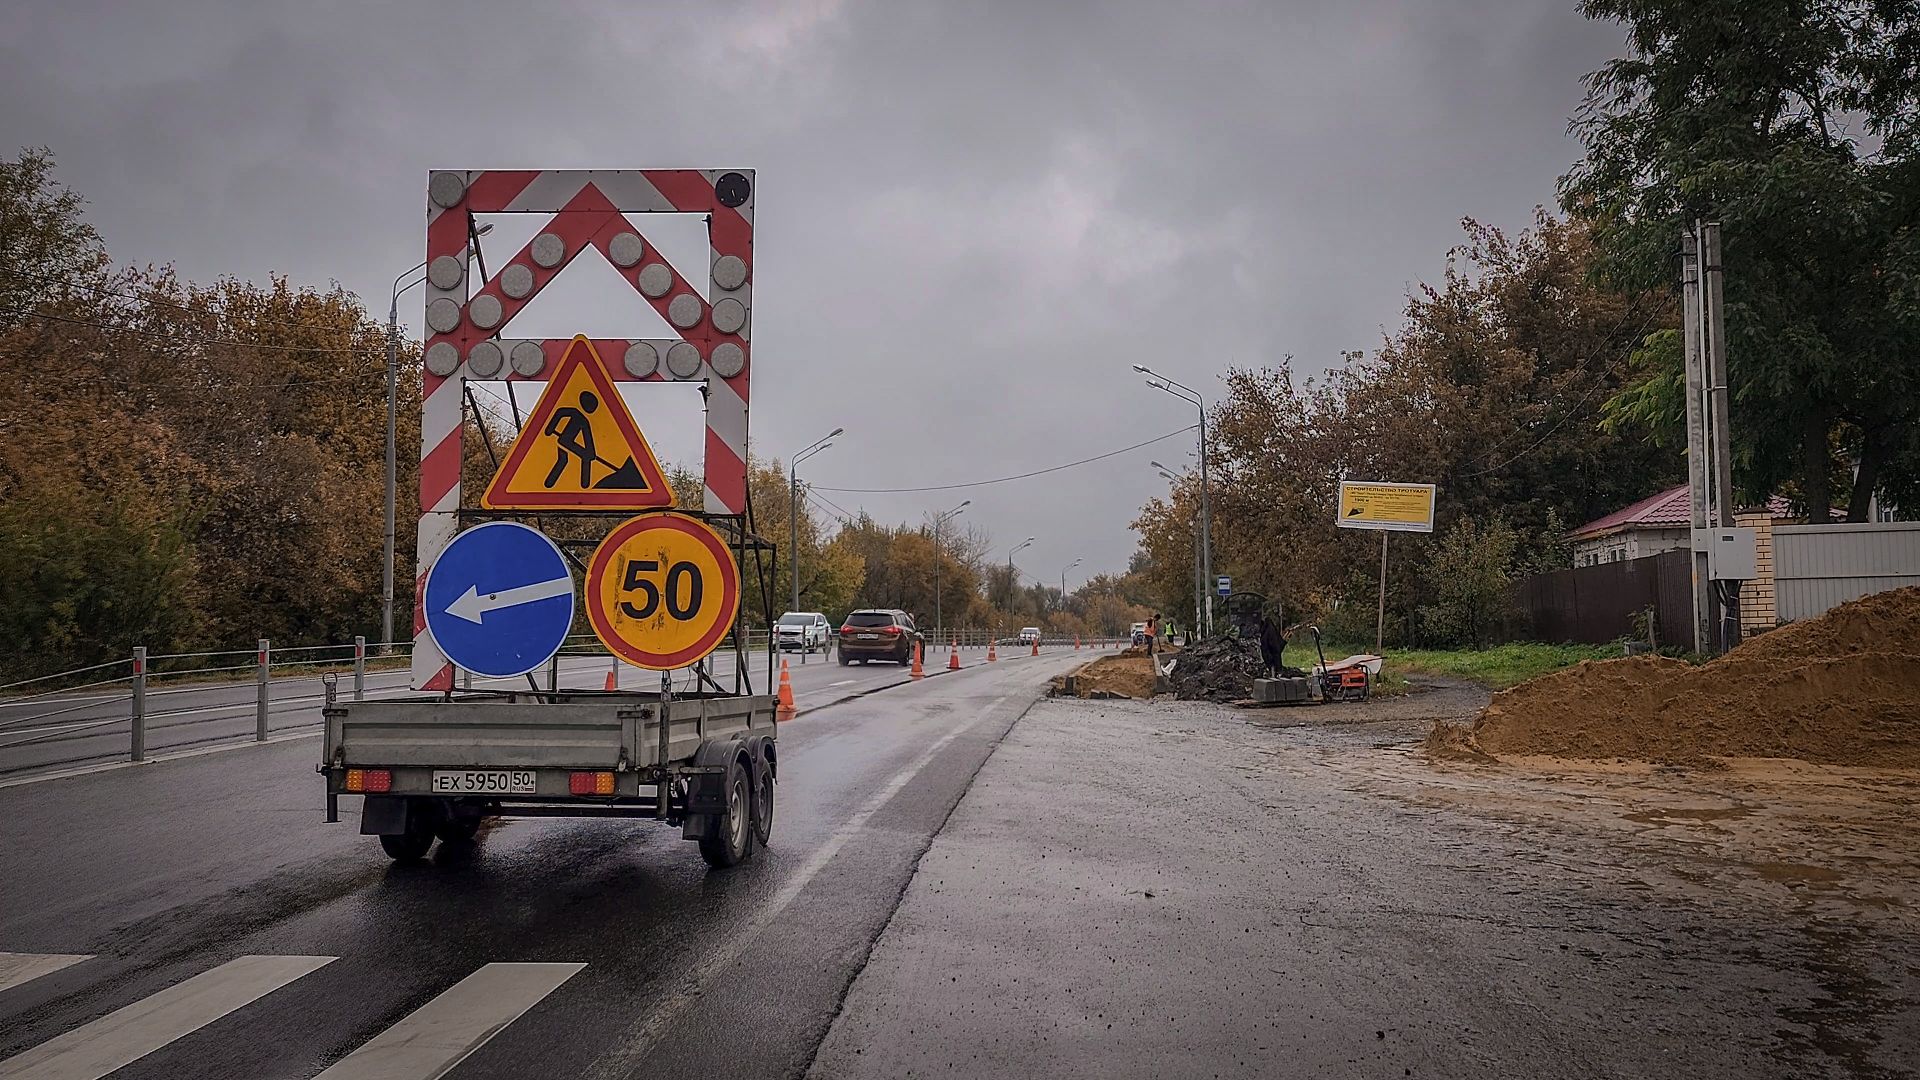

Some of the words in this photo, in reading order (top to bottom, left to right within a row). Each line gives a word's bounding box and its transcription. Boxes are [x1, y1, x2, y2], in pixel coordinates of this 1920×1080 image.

[620, 560, 703, 621] 50
[465, 773, 508, 790] 5950
[513, 773, 530, 786] 50
